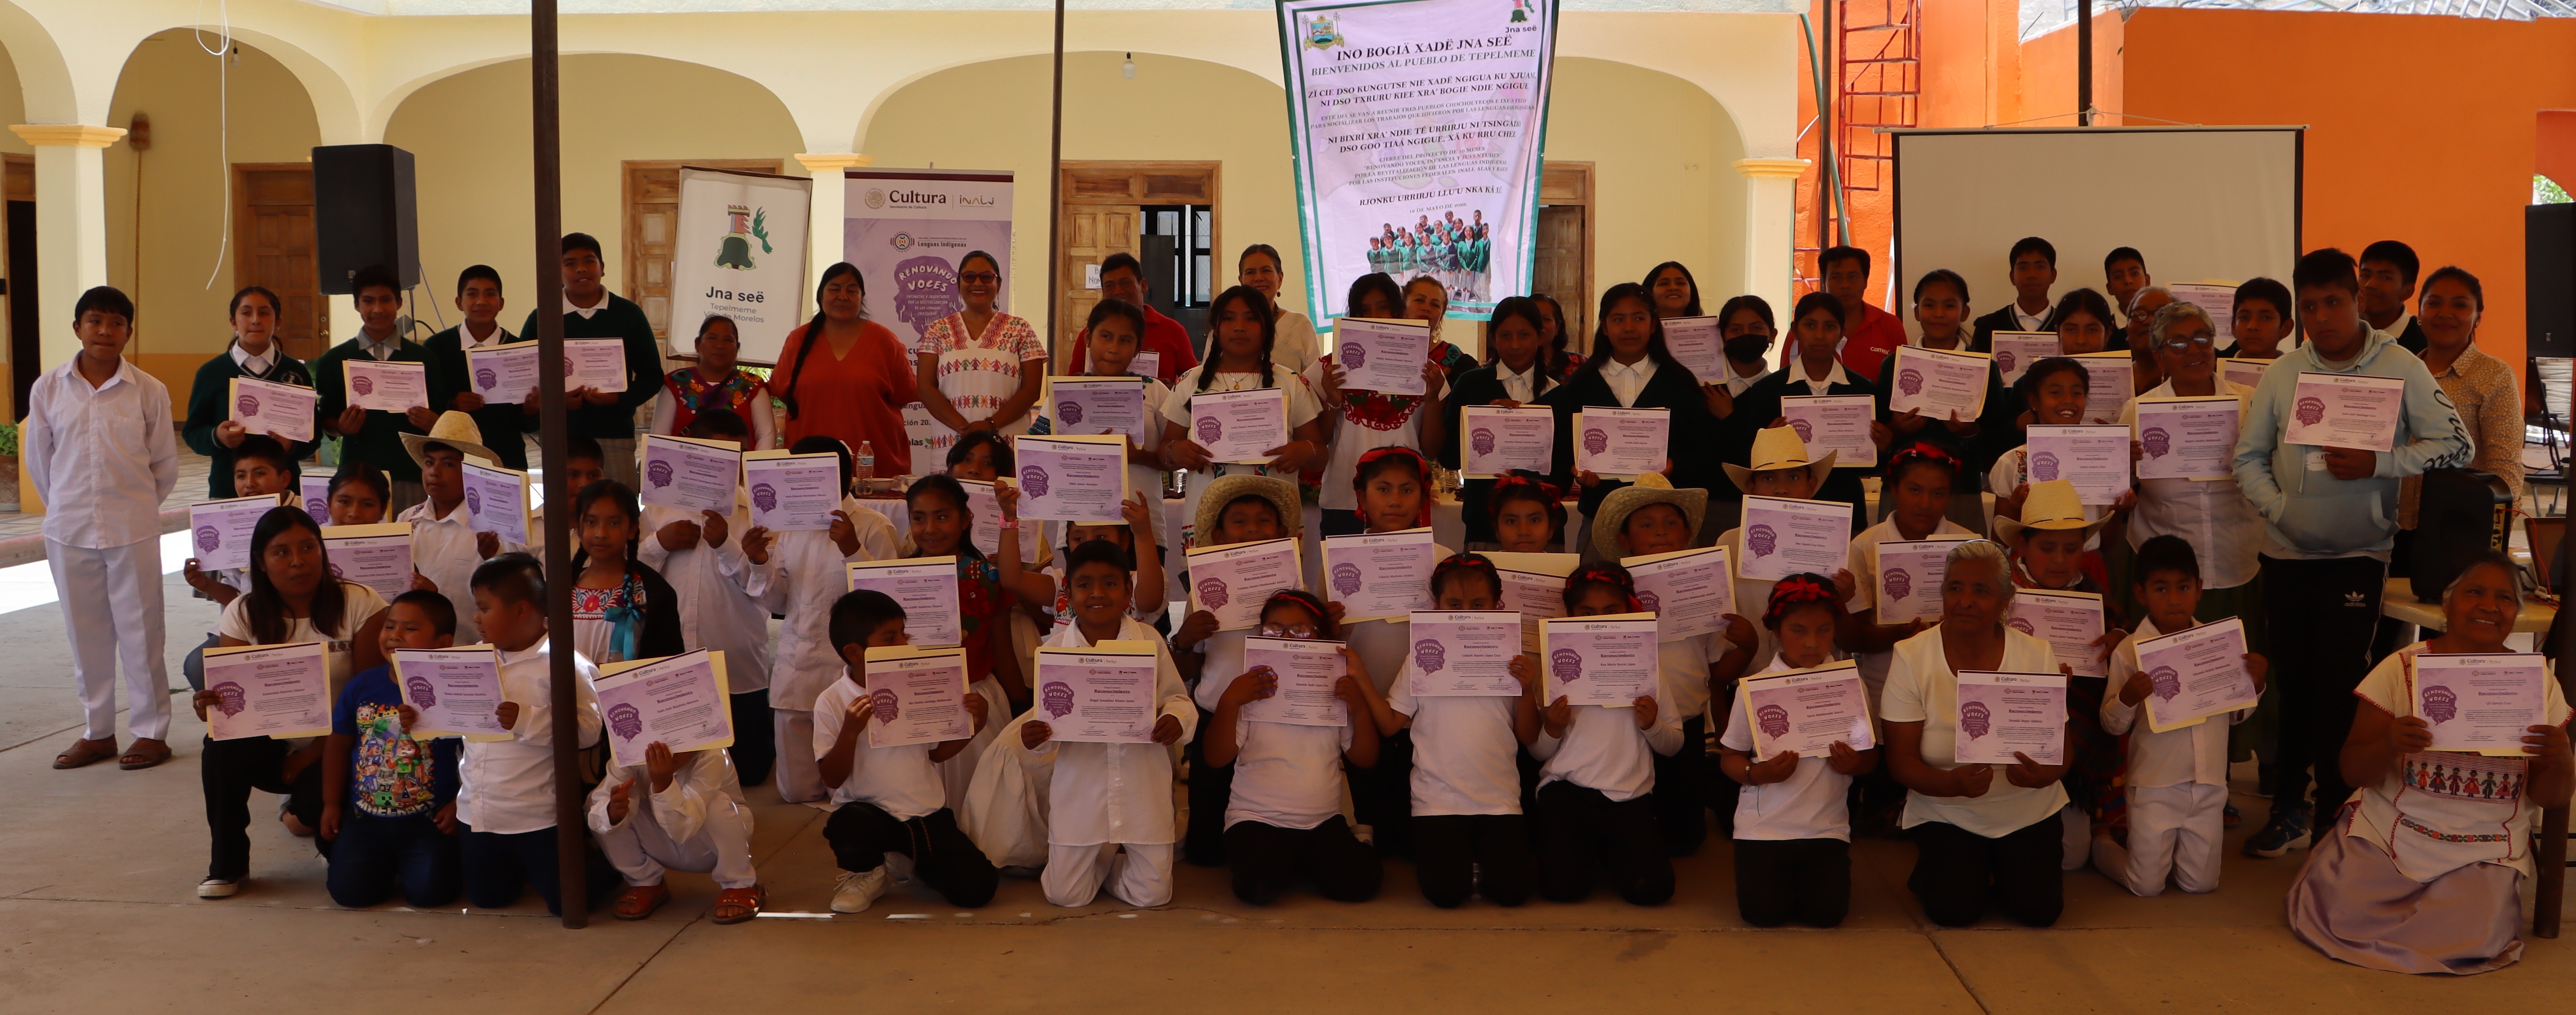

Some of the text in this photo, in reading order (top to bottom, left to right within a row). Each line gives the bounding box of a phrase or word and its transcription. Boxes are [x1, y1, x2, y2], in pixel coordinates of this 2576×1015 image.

[1337, 35, 1512, 60] INO BOGIÄ XADË JNA SEË
[1312, 61, 1385, 76] BIENVENIDOS
[1388, 60, 1401, 68] AL
[1405, 55, 1447, 67] PUEBLO
[1469, 50, 1536, 60] TEPELMEME
[1337, 87, 1355, 95] DSO
[1357, 81, 1407, 93] KUNGUTSE
[1456, 74, 1491, 82] NGIGUA
[1353, 93, 1391, 104] TXRURU
[1440, 86, 1468, 95] BOGIE
[1390, 129, 1412, 137] NDIE
[1429, 123, 1467, 132] URRIRJU
[1407, 135, 1445, 146] NGIGUE,
[1377, 165, 1427, 176] REVITALIZACIÓN
[1374, 174, 1420, 182] INSTITUCIONES
[889, 190, 946, 204] Cultura
[1359, 196, 1395, 206] RJONKU
[1398, 191, 1436, 202] URRIRJU
[899, 265, 957, 284] RENOVANDO
[907, 279, 948, 292] VOCES
[706, 286, 764, 302] Jna seë
[710, 303, 757, 314] Tepelmeme
[657, 691, 693, 704] Reconocimiento
[2424, 690, 2454, 699] RENOVANDO
